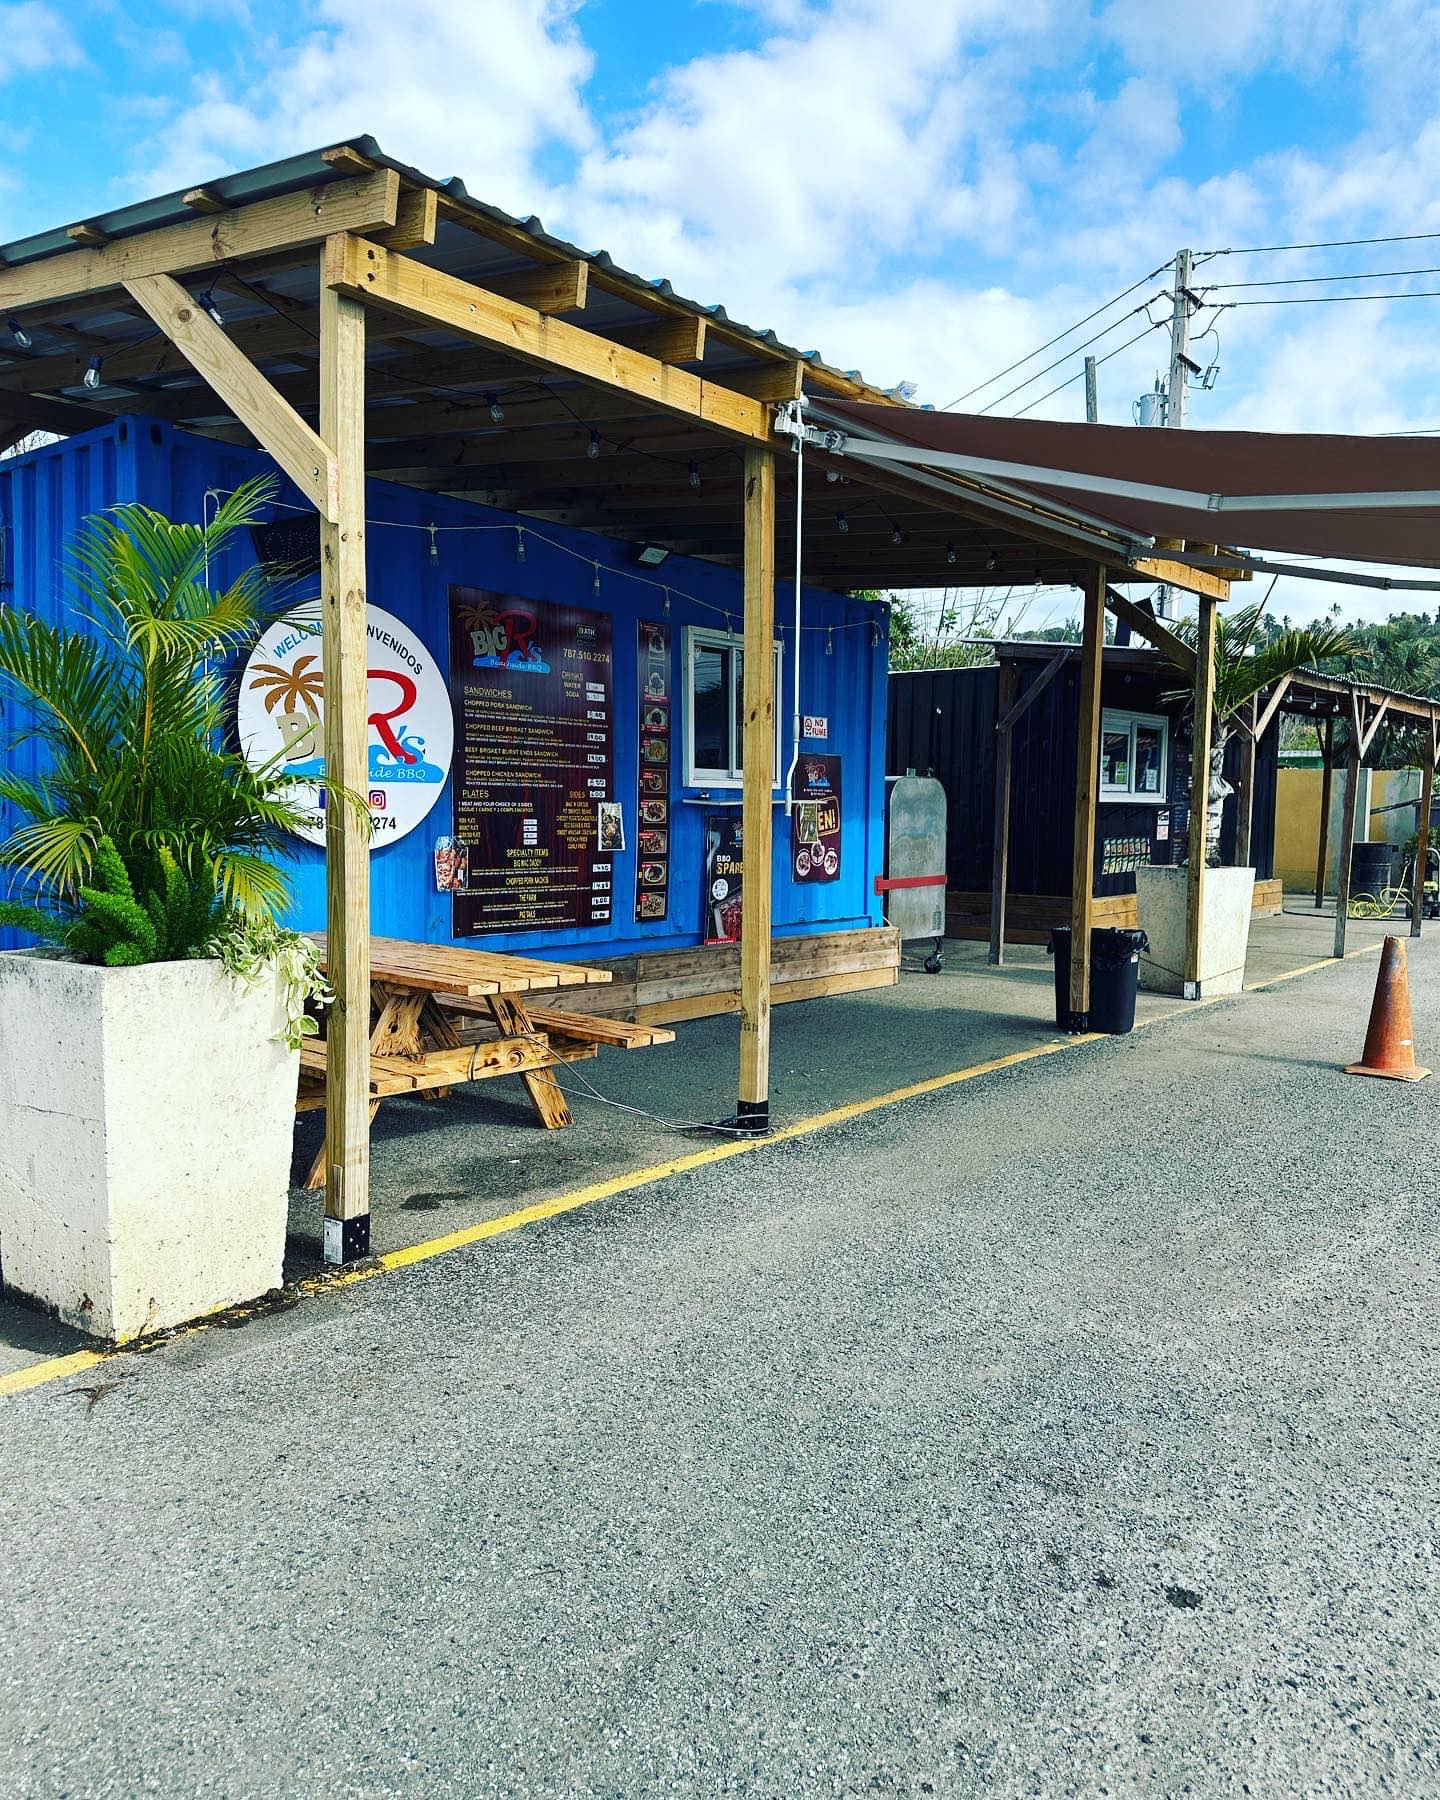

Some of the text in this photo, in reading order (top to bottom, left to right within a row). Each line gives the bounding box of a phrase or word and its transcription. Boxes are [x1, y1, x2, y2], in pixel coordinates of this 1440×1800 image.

[273, 621, 323, 659] WELCOM
[470, 625, 508, 657] BIG
[366, 623, 424, 676] NVENIDOS
[464, 685, 513, 698] SANDWICHES
[563, 682, 581, 690] WATER
[464, 699, 490, 707] CHOPPED
[505, 703, 533, 711] SANDWICH
[465, 723, 491, 731] CHOPPED
[528, 727, 554, 735] SANDWICH
[815, 719, 824, 727] NO
[534, 750, 559, 758] SANDWICH
[397, 768, 426, 781] BBQ
[462, 789, 489, 798] PLATES
[818, 808, 836, 831] EN!
[506, 848, 549, 857] SPECIALTY ITEMS
